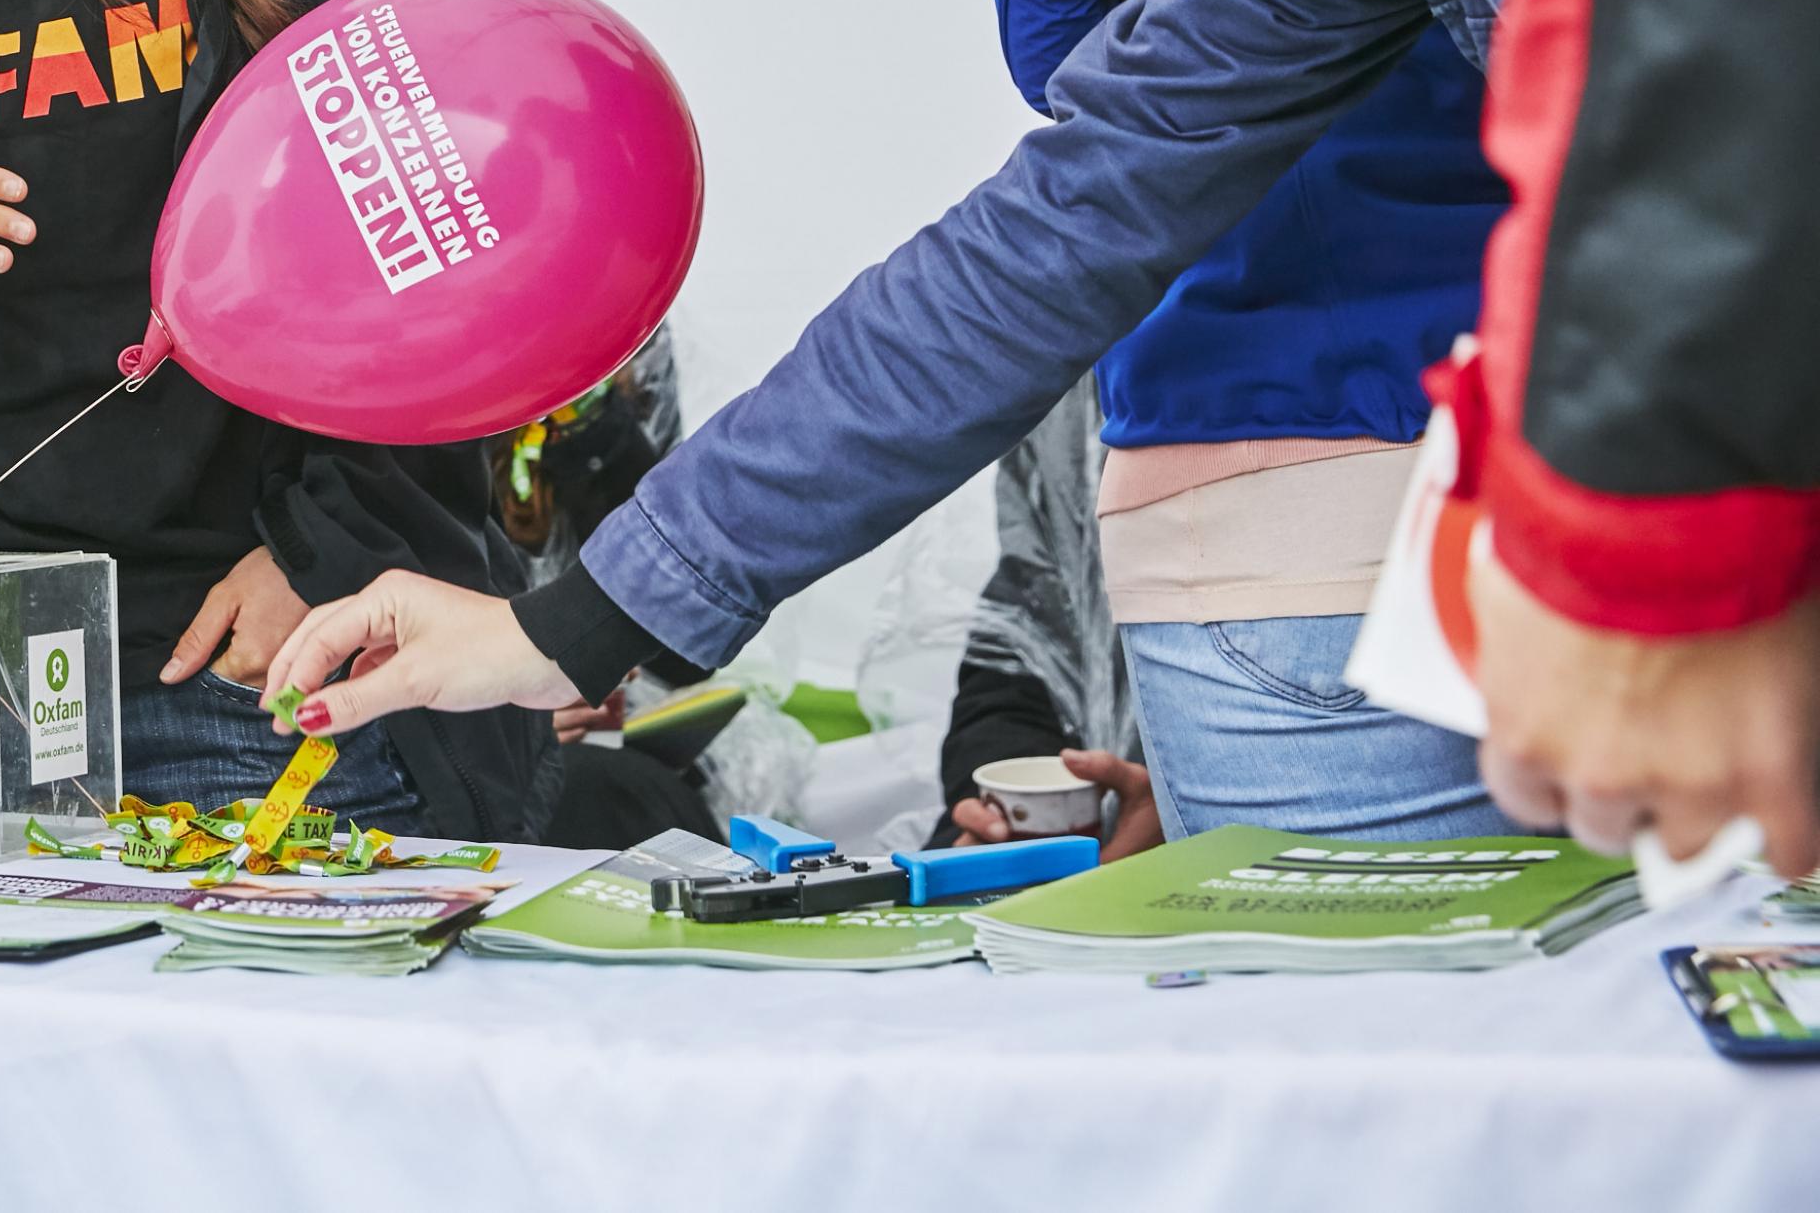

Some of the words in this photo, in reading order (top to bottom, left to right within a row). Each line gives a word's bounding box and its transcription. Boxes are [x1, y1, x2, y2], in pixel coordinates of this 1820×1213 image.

[371, 3, 500, 249] STEUERVERMEIDUNG
[342, 14, 380, 68] VON
[362, 66, 473, 265] KONZERNEN
[294, 43, 428, 278] STOPPEN!
[34, 697, 83, 725] Oxfam
[40, 722, 79, 737] Deutschland
[35, 743, 84, 760] www.oxfam.de
[303, 822, 330, 838] TAX
[123, 841, 147, 858] AIR
